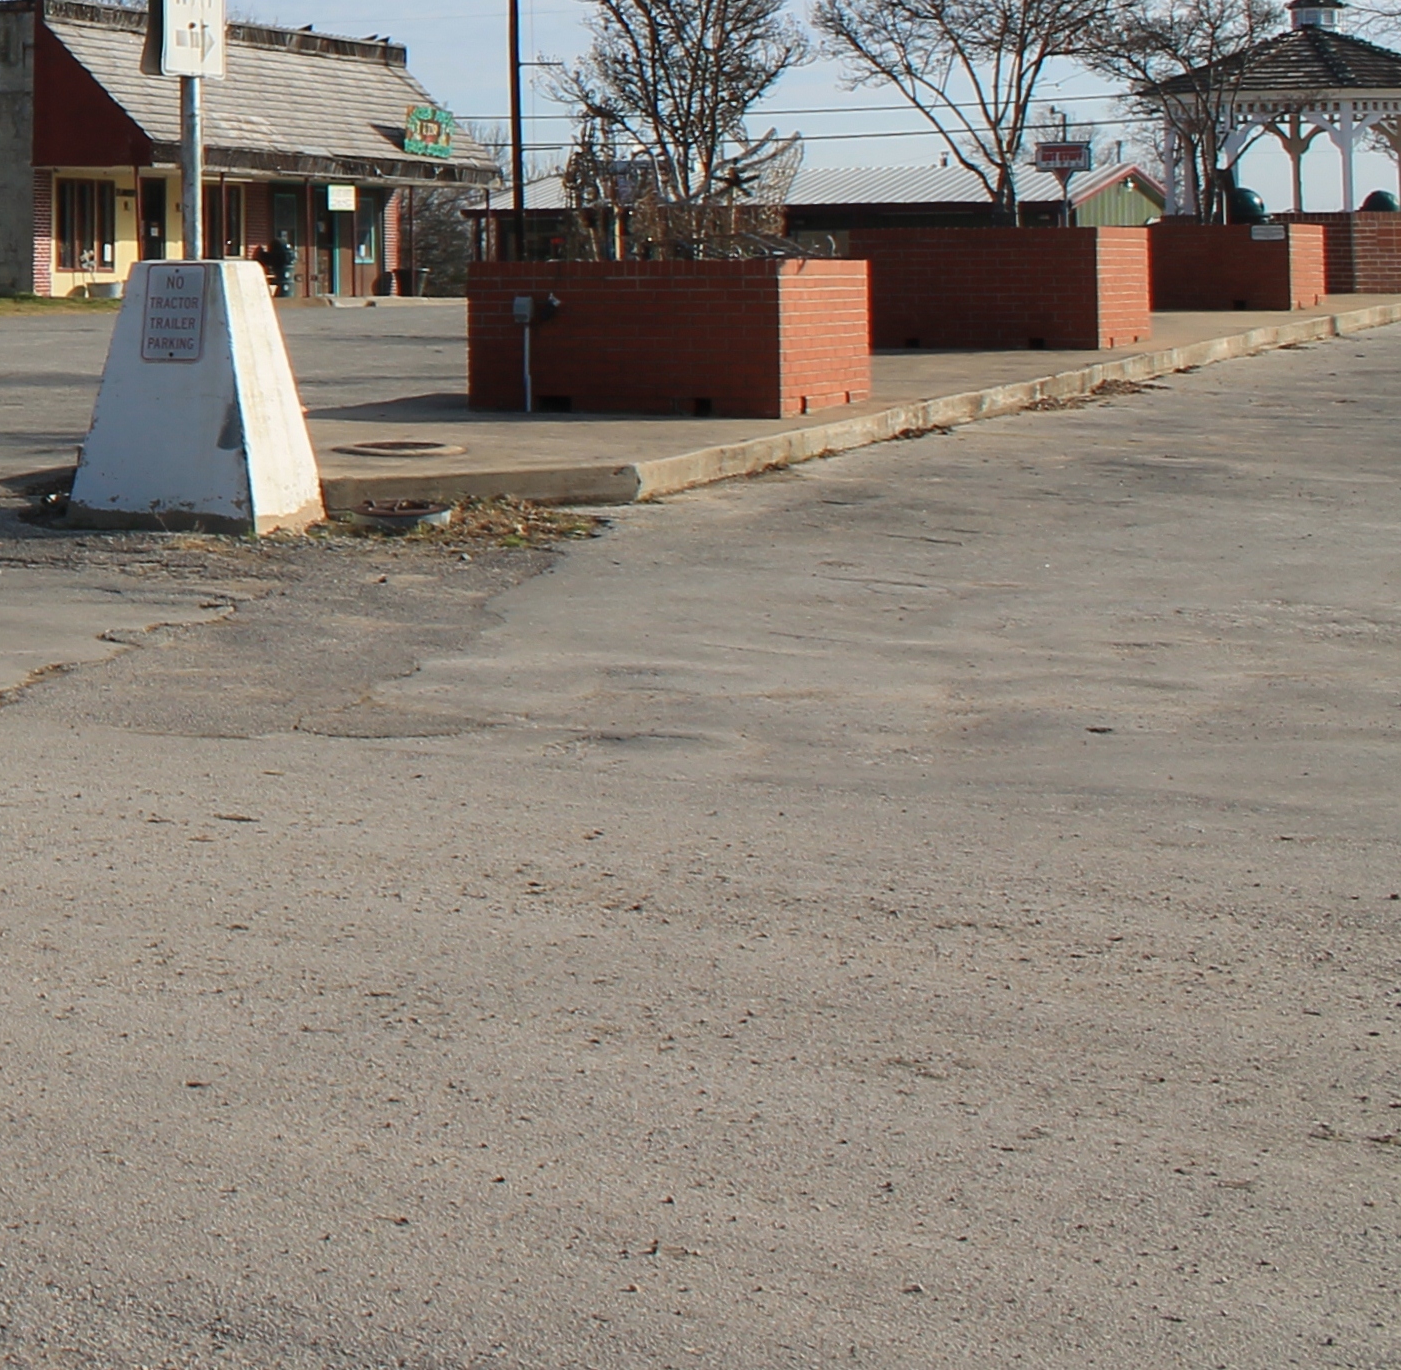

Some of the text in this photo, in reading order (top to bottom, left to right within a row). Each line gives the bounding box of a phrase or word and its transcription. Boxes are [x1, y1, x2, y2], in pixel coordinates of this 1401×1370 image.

[166, 276, 185, 290] NO
[149, 296, 199, 310] TRACTOR
[149, 317, 196, 330] TRAILER
[147, 337, 195, 350] PARKING
